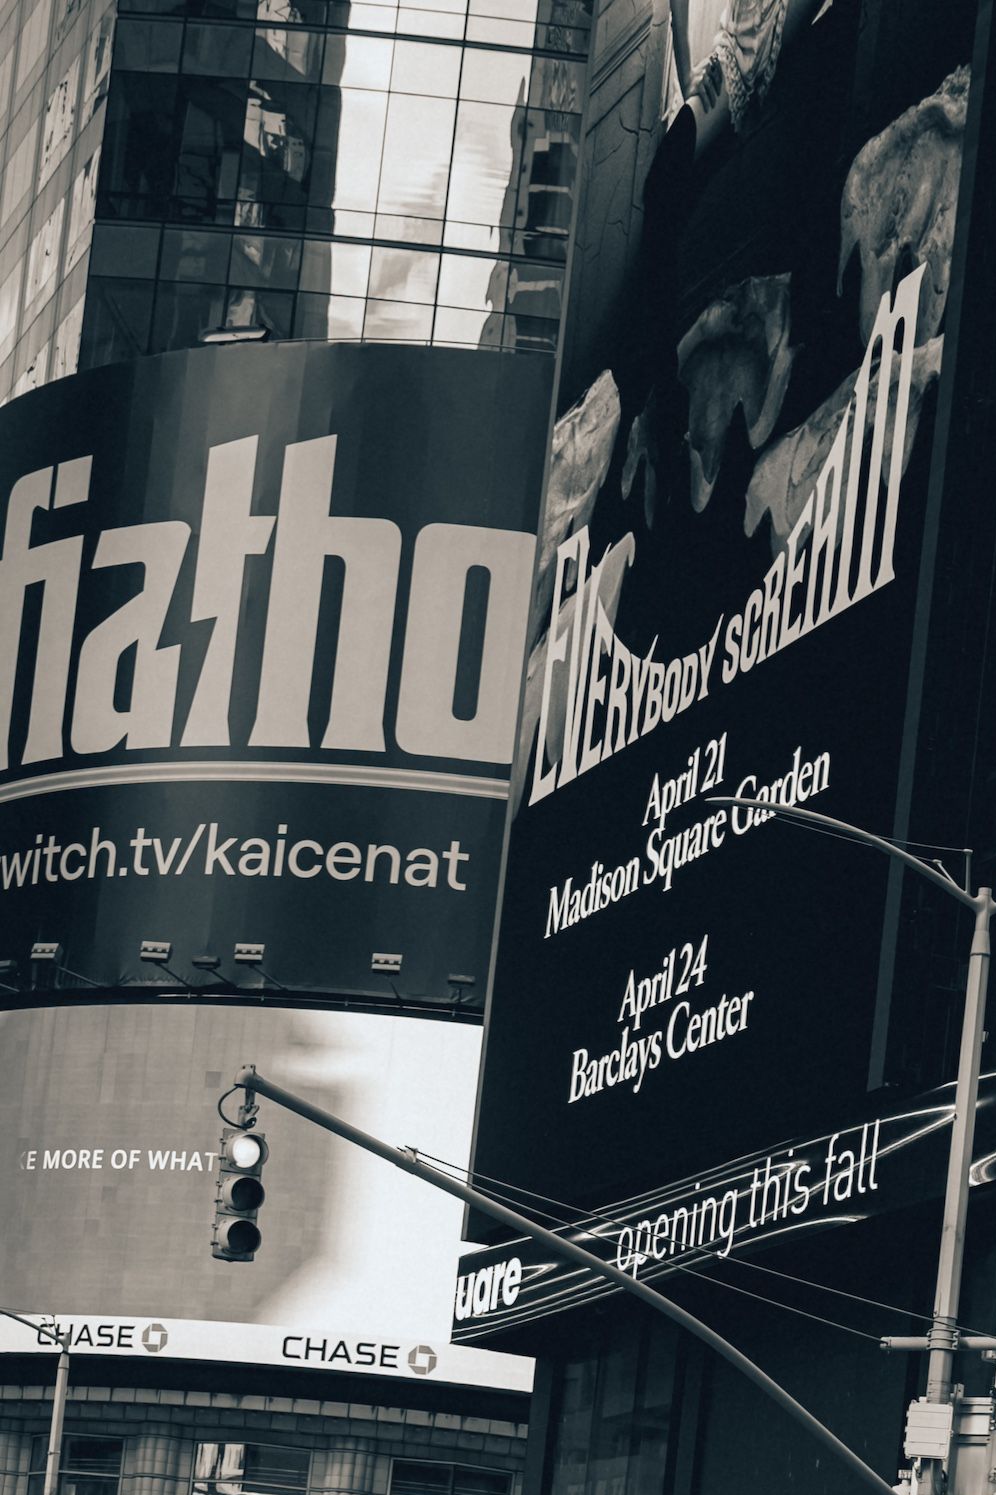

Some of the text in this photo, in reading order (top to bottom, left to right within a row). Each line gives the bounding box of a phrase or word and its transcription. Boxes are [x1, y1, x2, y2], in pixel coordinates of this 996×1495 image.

[528, 262, 926, 807] EVERYBODY SCREAM
[642, 732, 728, 836] April 21
[0, 822, 470, 891] witch.tv/kaicenat
[544, 746, 831, 938] Madison Square Garden
[617, 934, 709, 1031] April 24
[568, 991, 755, 1104] Barclays Center
[43, 1149, 104, 1170] MORE
[110, 1149, 141, 1170] OF
[148, 1150, 219, 1171] WHAT
[617, 1119, 880, 1280] opening this fall
[37, 1323, 135, 1348] CHASE
[455, 1257, 522, 1320] uare
[282, 1335, 400, 1369] CHASE
